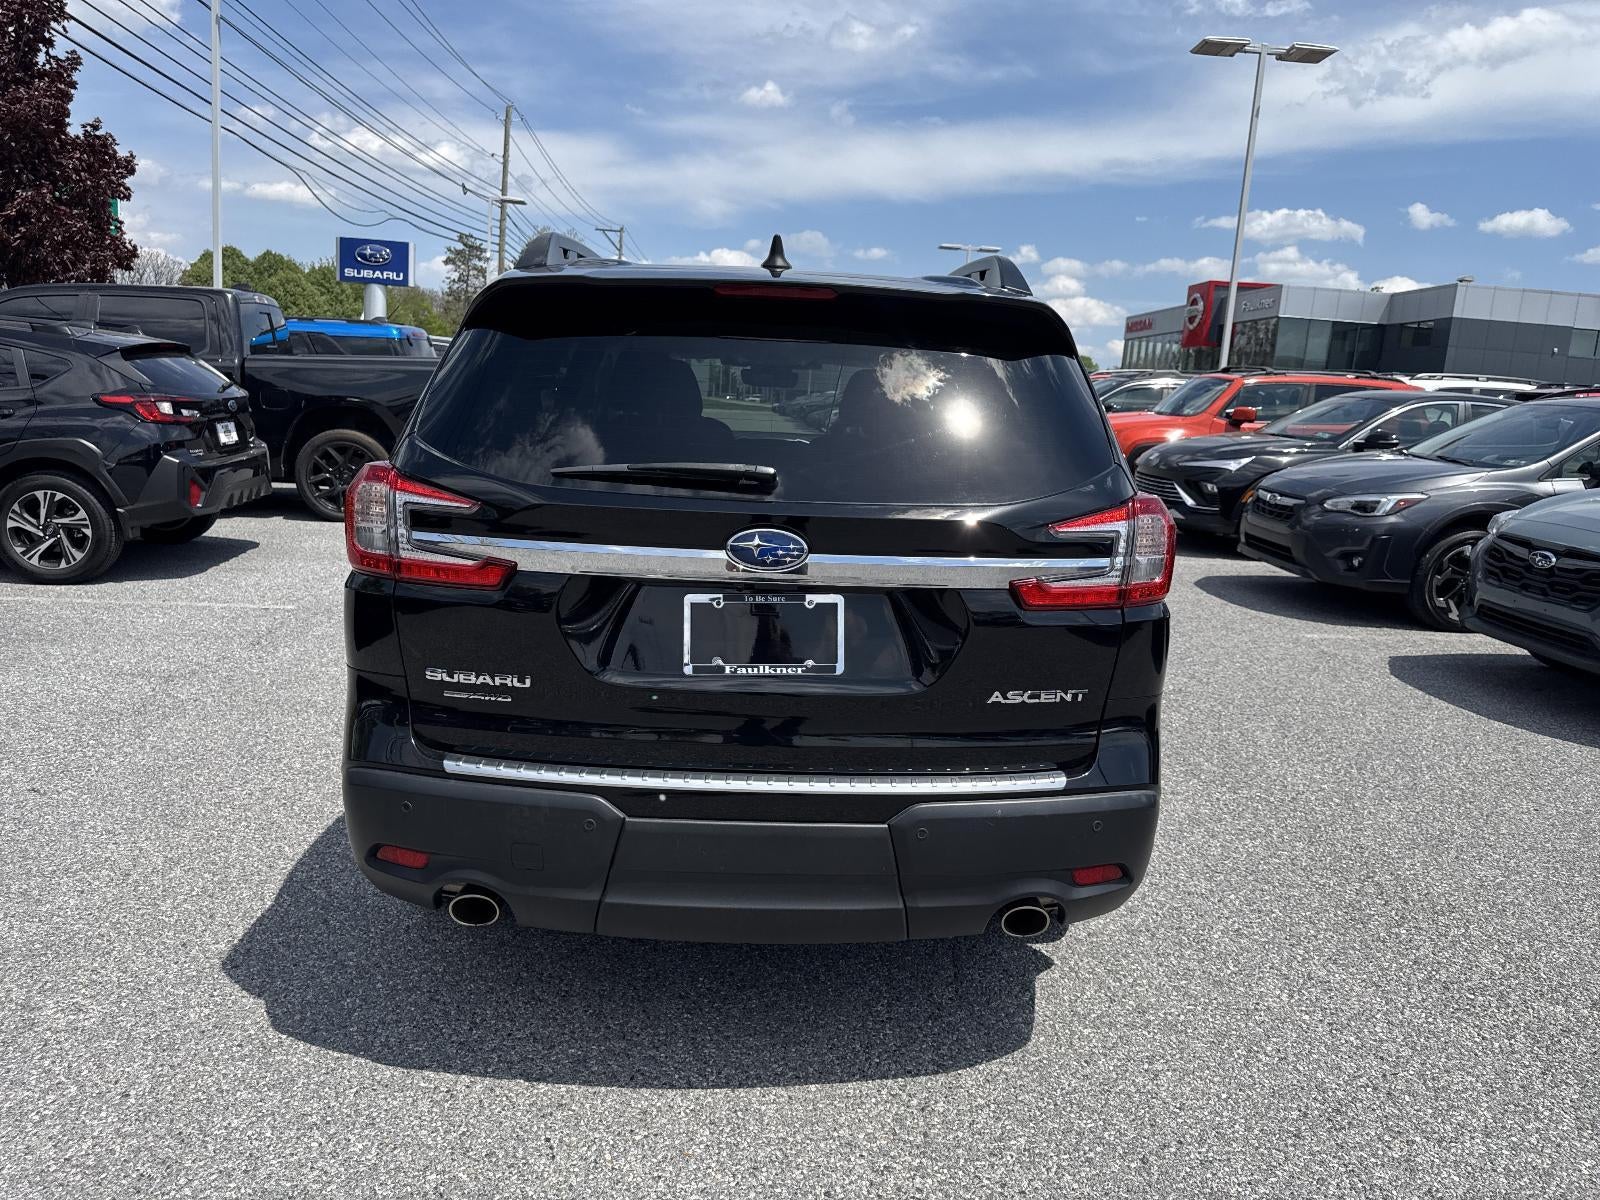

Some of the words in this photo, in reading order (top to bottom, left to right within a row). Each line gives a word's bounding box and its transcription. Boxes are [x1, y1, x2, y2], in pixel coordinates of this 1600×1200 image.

[344, 268, 403, 280] SUBARU
[1127, 317, 1153, 333] NISSAN
[724, 665, 806, 674] Faulkner
[425, 667, 531, 688] SUBARU
[986, 689, 1089, 704] ASCENT
